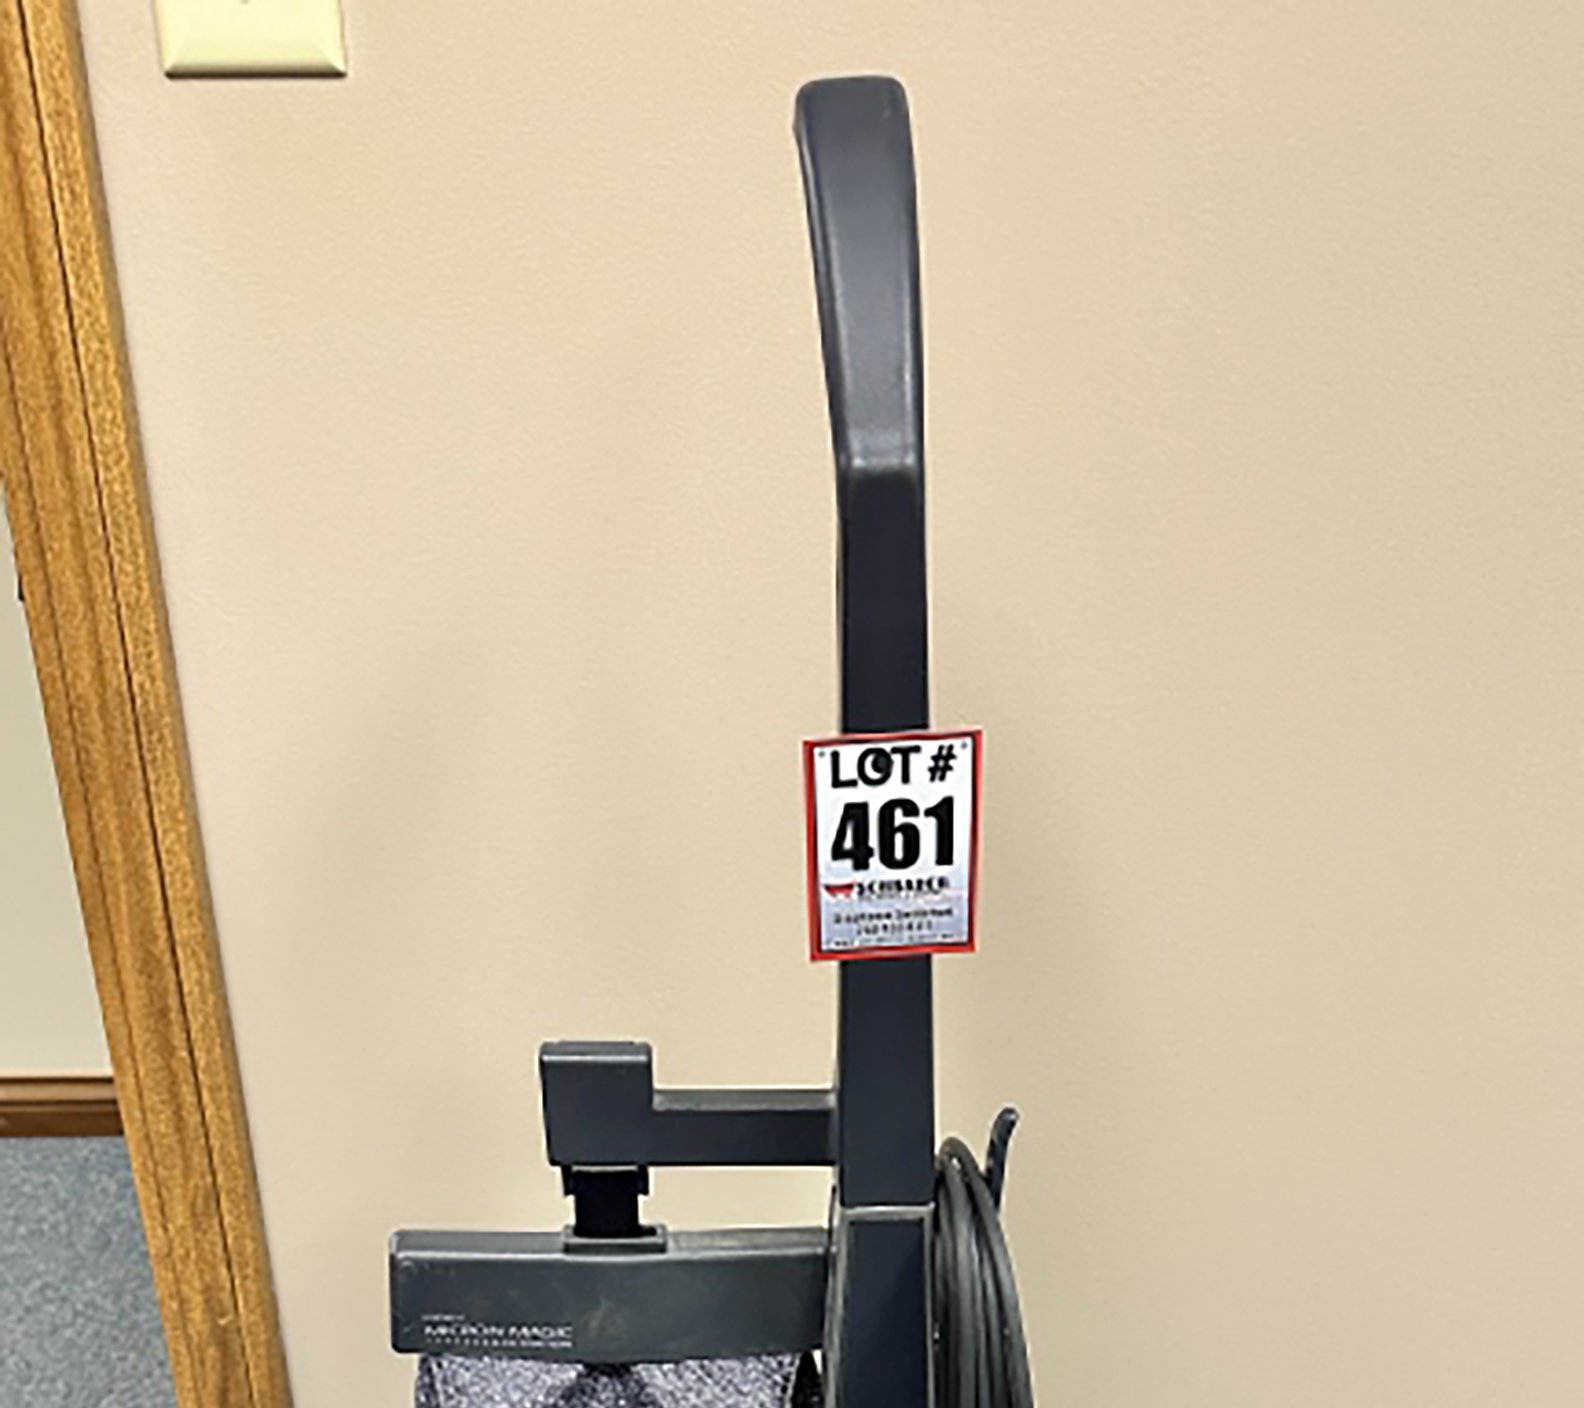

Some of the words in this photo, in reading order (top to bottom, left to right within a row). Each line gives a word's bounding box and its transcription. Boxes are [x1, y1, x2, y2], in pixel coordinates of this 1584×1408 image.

[830, 745, 922, 788] LOT
[928, 744, 958, 782] #
[831, 796, 954, 871] 461
